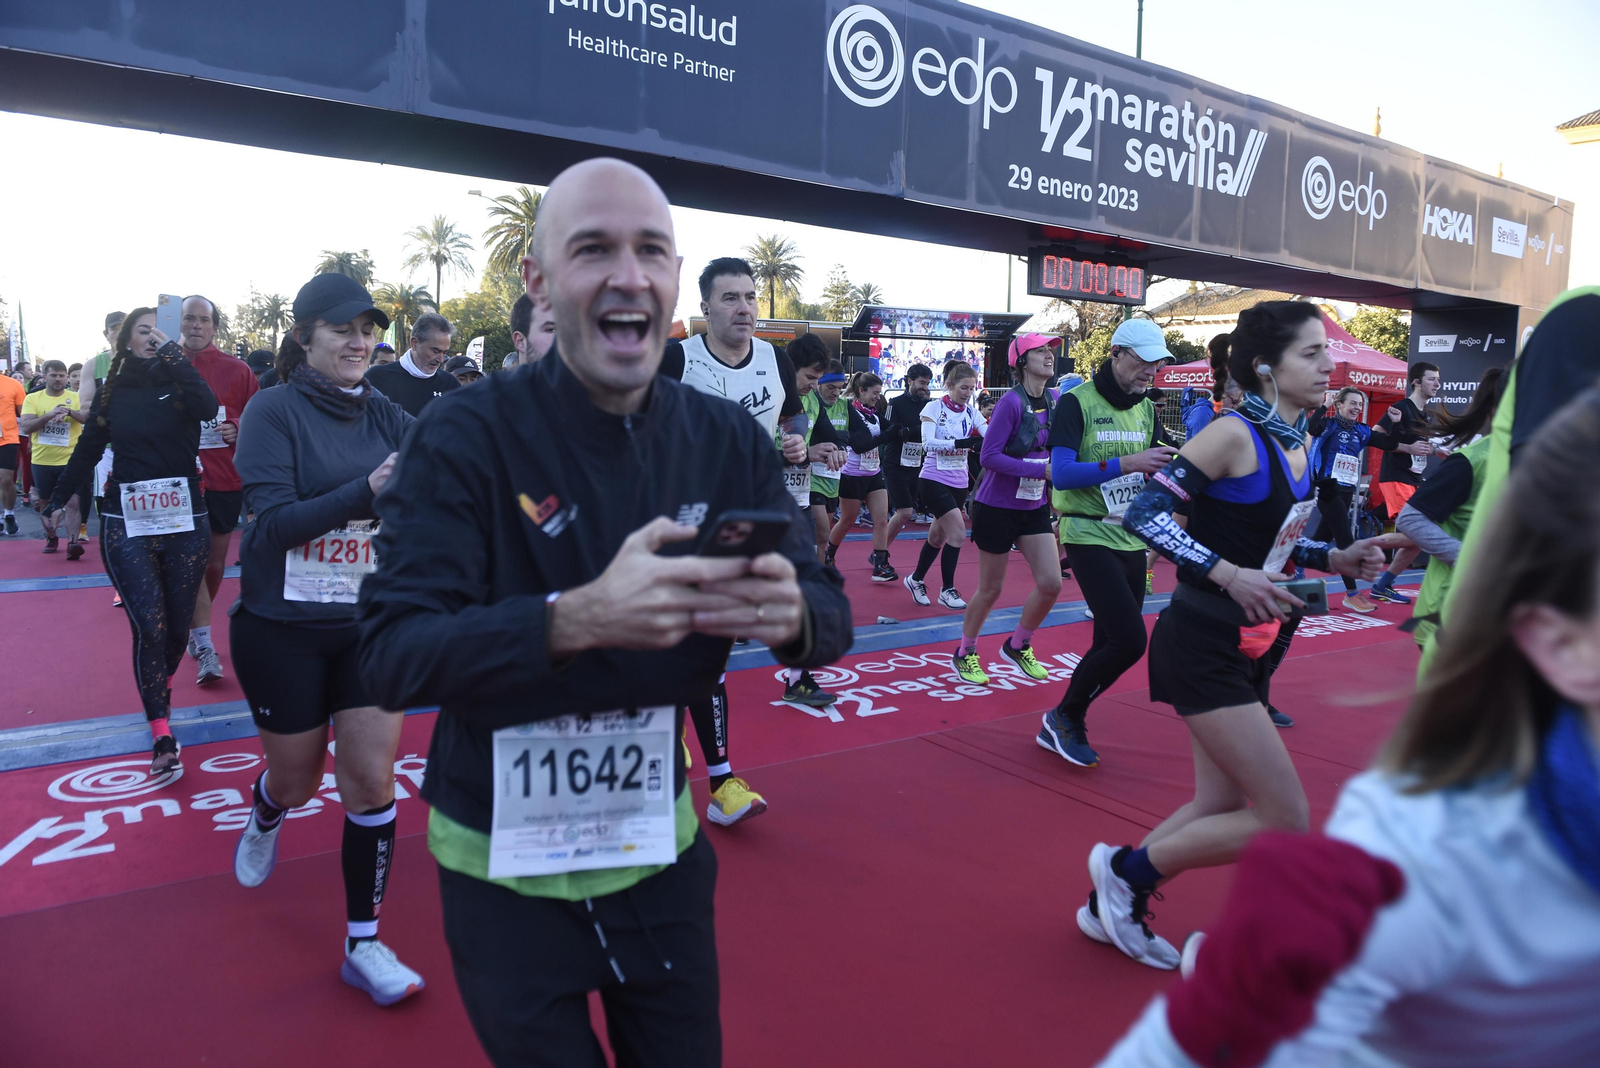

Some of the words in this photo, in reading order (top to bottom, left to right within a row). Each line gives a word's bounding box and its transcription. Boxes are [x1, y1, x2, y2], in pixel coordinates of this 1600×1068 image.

[568, 28, 668, 68] Healthcare
[674, 52, 736, 82] Partner
[912, 37, 1018, 129] edp
[1084, 81, 1236, 156] maratón
[1008, 164, 1033, 190] 29
[1037, 174, 1092, 203] enero
[1097, 183, 1139, 212] 2023
[1123, 137, 1237, 197] sevilla
[1338, 172, 1387, 231] edp
[1422, 203, 1475, 246] HOKA
[42, 425, 66, 436] 12490
[1093, 417, 1114, 425] HOKA
[1096, 430, 1120, 442] MEDIO
[128, 491, 181, 511] 11706
[1144, 521, 1161, 534] TO
[1153, 511, 1195, 546] BACK
[303, 538, 370, 564] 11281
[512, 744, 644, 799] 11642
